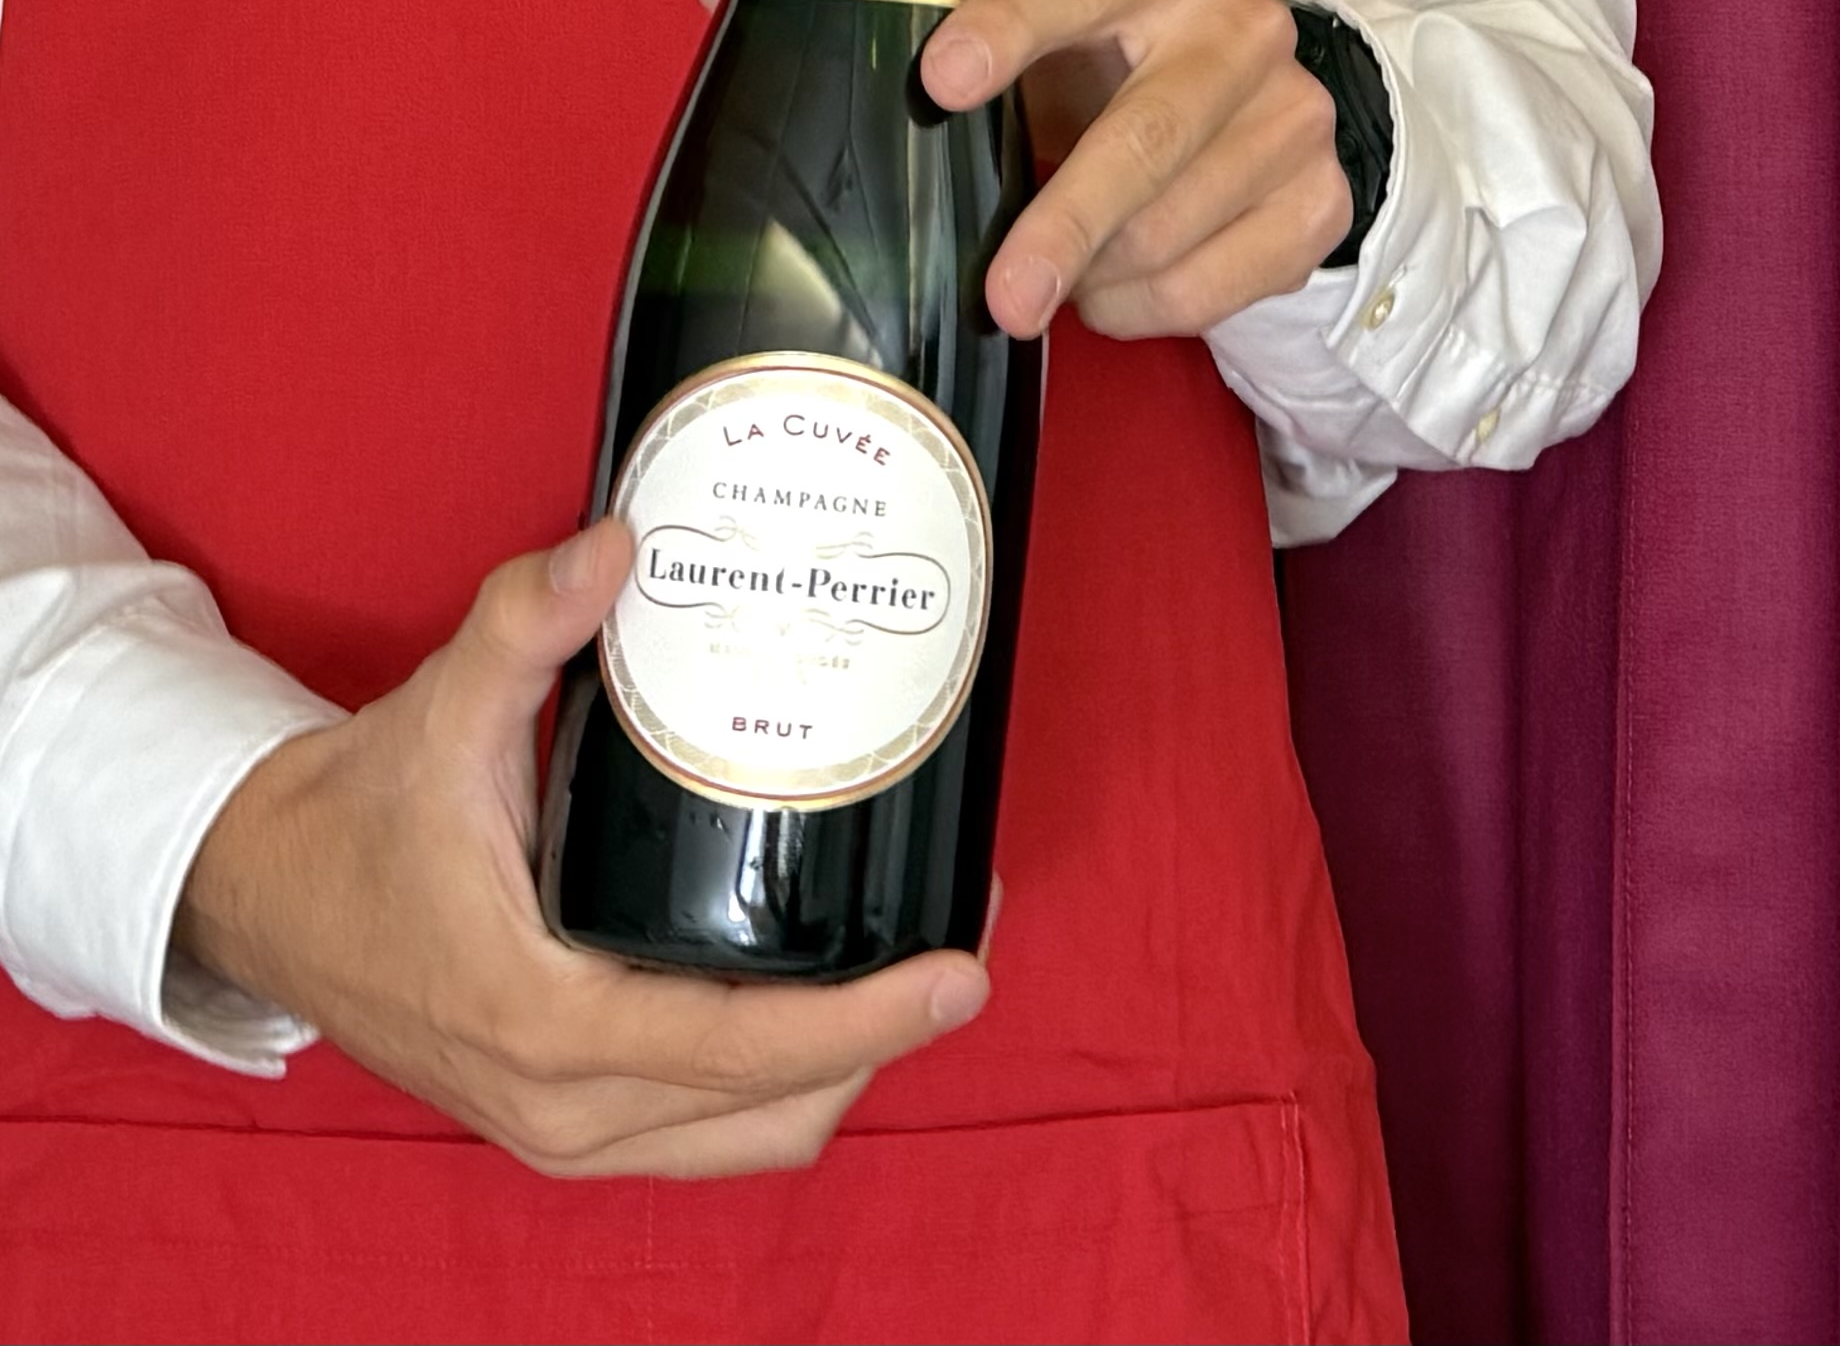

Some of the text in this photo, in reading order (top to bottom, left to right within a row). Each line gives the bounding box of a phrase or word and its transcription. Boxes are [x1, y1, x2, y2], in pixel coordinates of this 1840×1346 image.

[711, 481, 888, 518] CHAMPAGNE
[648, 547, 936, 612] Laurent-Perrier
[731, 715, 814, 740] BRUT
